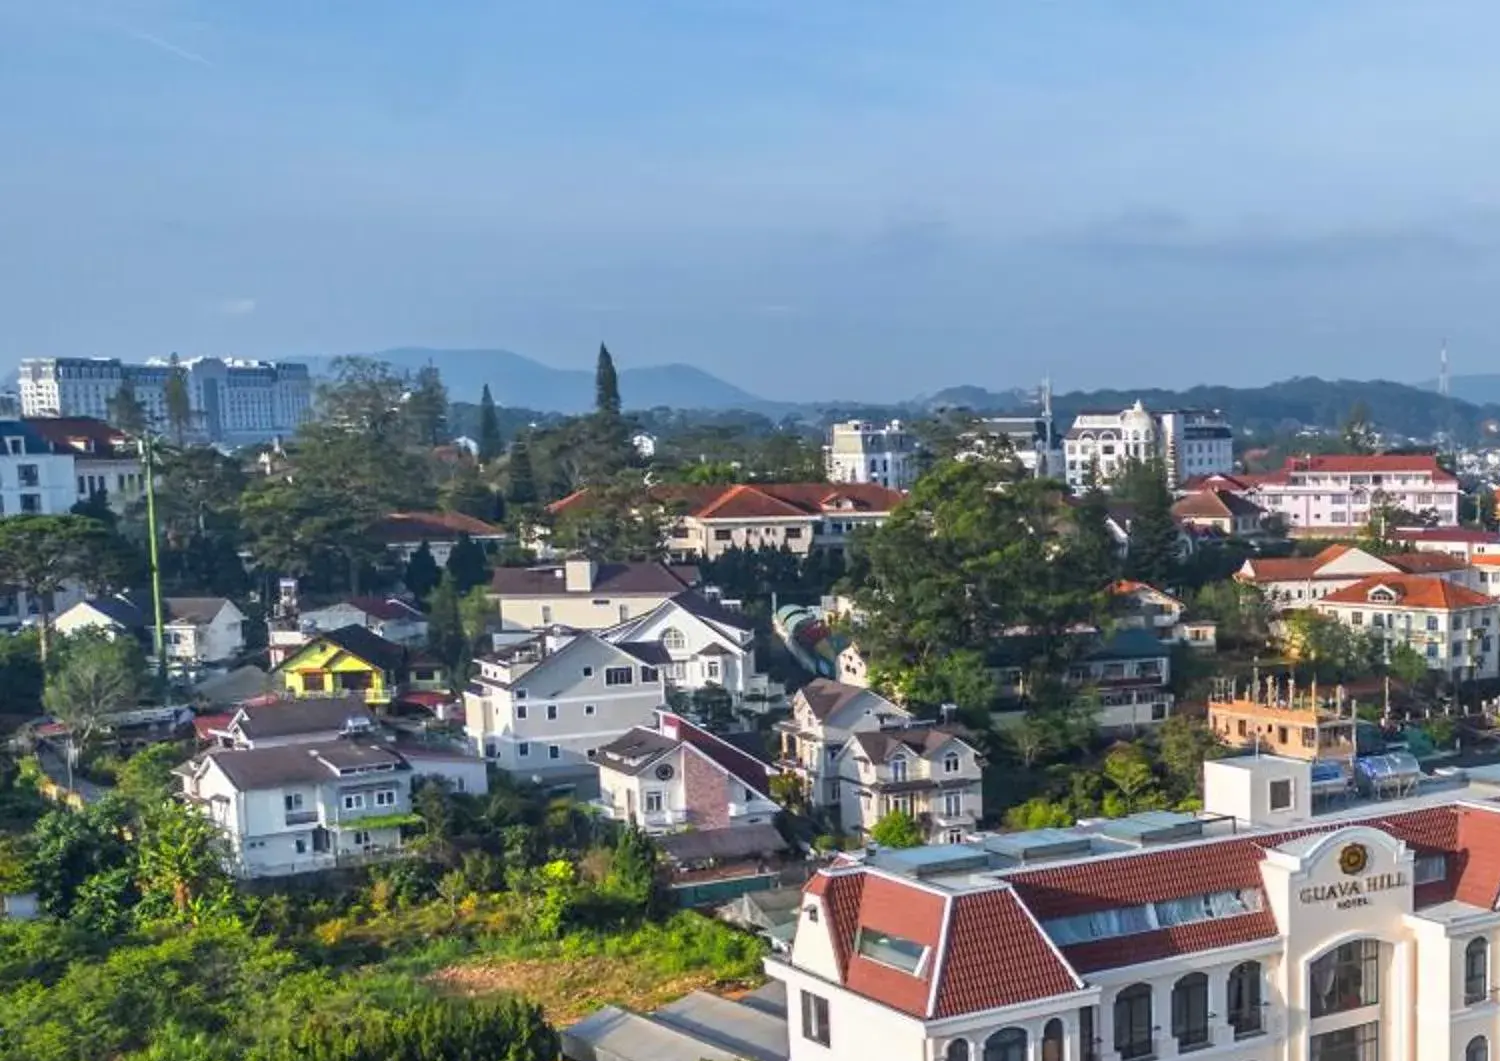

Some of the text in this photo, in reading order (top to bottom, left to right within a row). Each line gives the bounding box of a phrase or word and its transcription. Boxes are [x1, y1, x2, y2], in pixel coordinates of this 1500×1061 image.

[1299, 871, 1408, 904] GUAVA HILL
[1336, 897, 1369, 910] HOTEL
